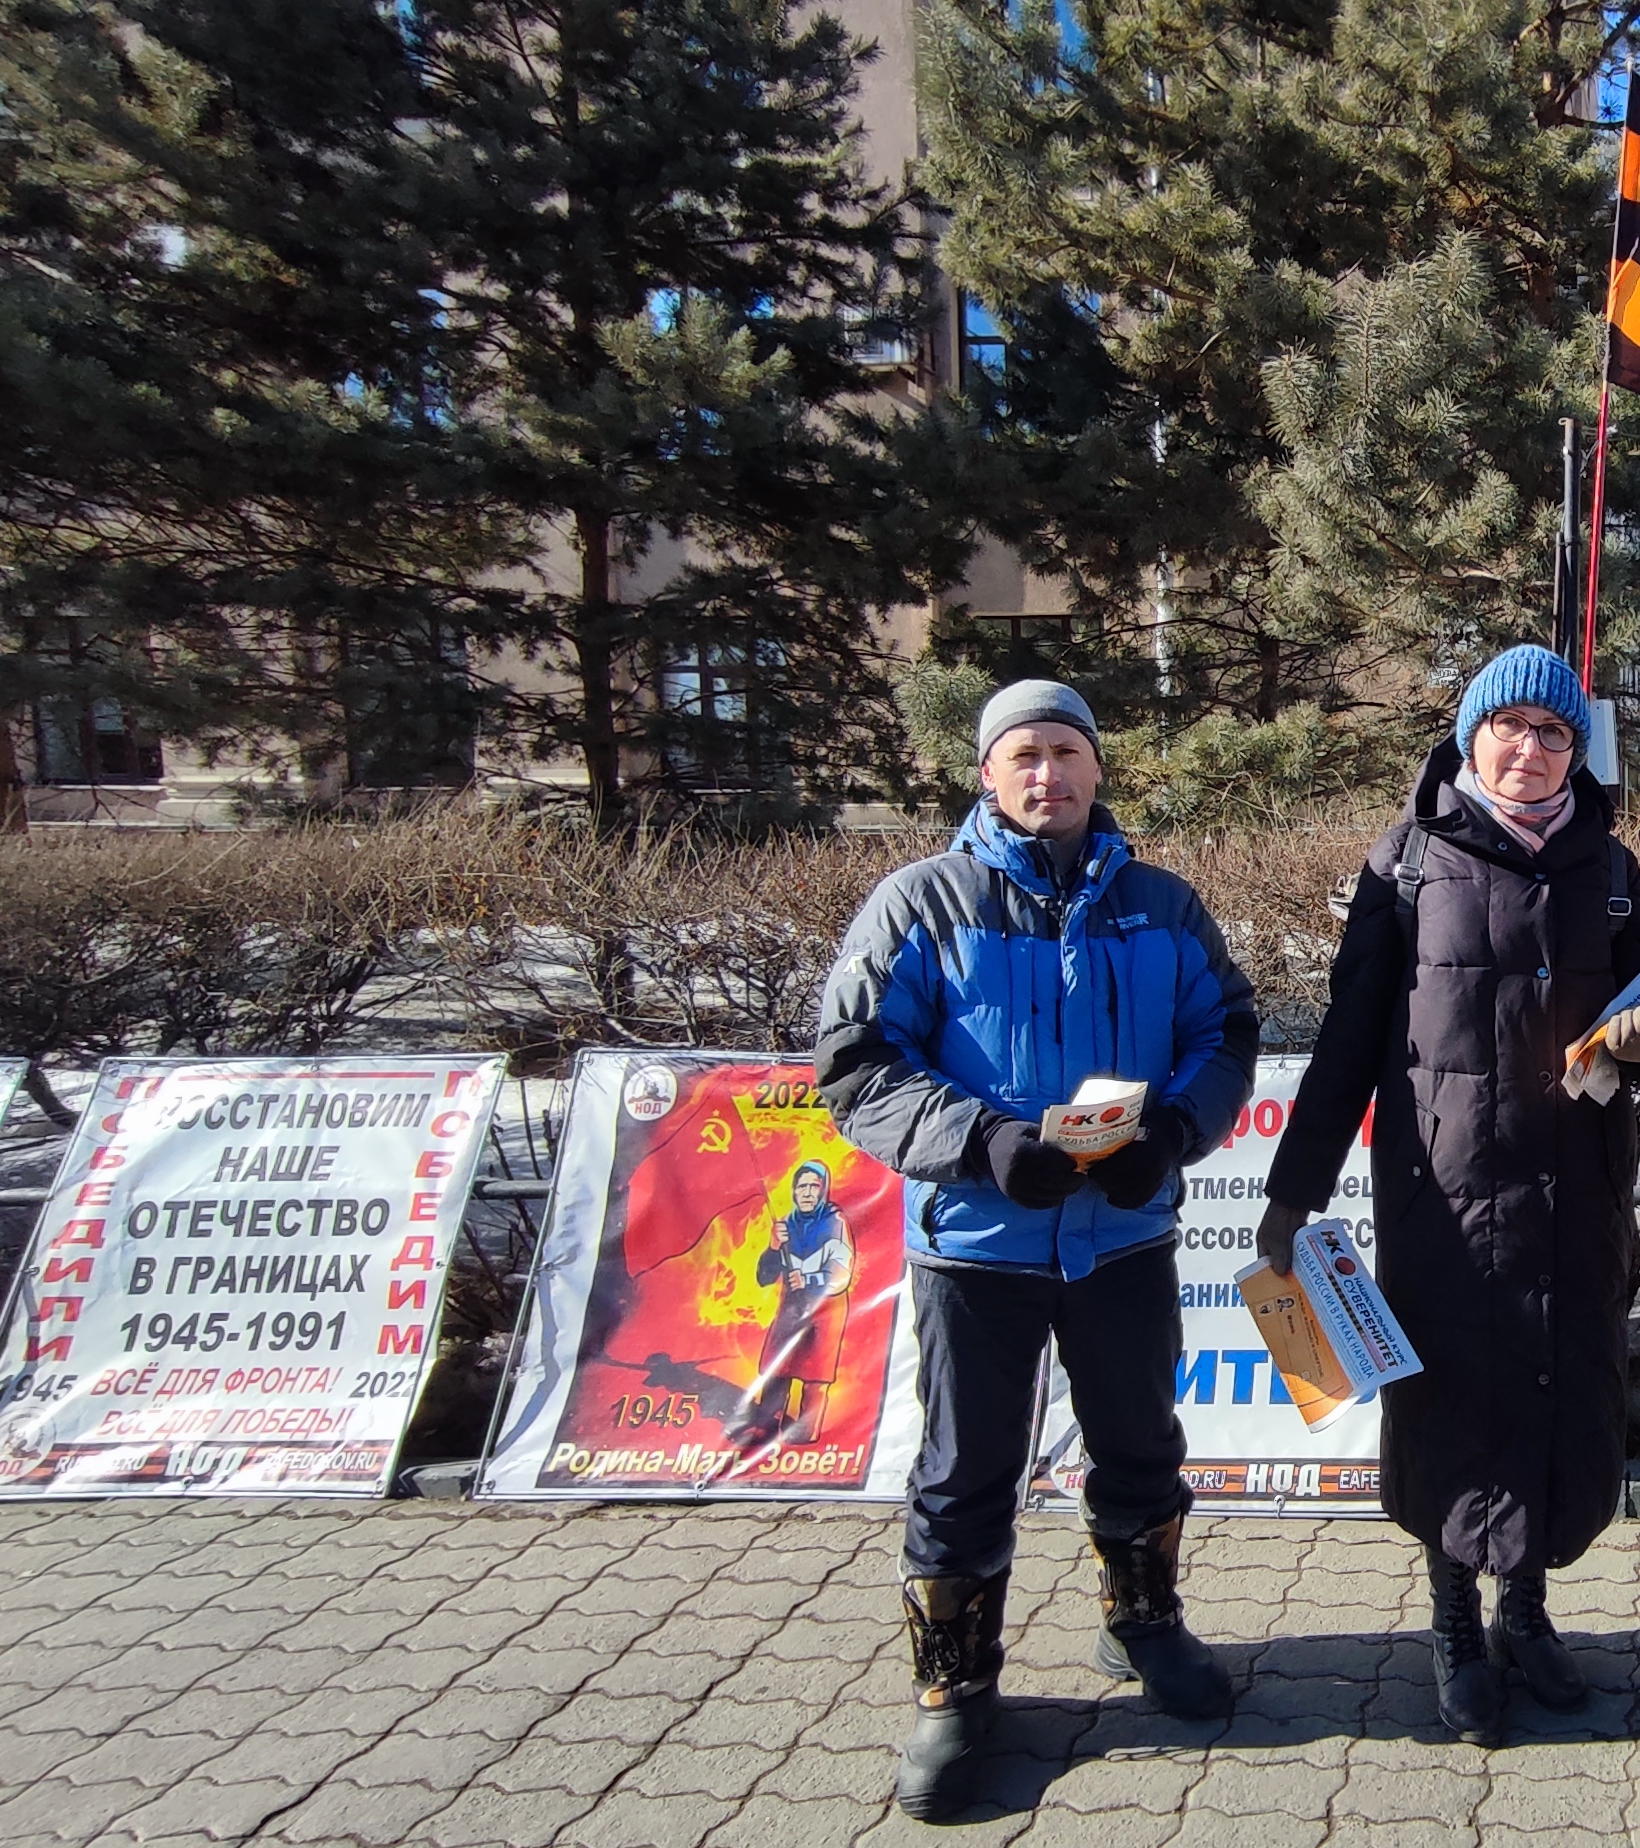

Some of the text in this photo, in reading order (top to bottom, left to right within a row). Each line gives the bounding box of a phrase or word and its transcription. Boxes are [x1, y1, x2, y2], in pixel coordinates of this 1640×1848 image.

[635, 1102, 662, 1115] НОД
[1061, 1112, 1097, 1126] НК
[1057, 1134, 1099, 1145] СУДЬБА
[213, 1145, 341, 1182] НАШЕ
[127, 1198, 391, 1240] ОТЕЧЕСТВО
[1295, 1240, 1318, 1274] СУДЬБА
[1319, 1230, 1345, 1256] НК
[128, 1254, 373, 1301] В ГРАНИЦАХ
[1313, 1270, 1334, 1307] РОССИИ
[1328, 1306, 1341, 1316] В
[1342, 1278, 1399, 1369] СУВЕРЕНИТЕТ
[1353, 1276, 1408, 1366] НАЦИОНАЛЬНЫЙ КУРС
[119, 1311, 348, 1353] 1945-1991
[1333, 1314, 1356, 1345] РУКАХ
[1348, 1341, 1375, 1381] НАРОДА
[0, 1374, 79, 1403] 1945
[90, 1361, 345, 1402] ВСЁ ДЛЯ ФРОНТА!
[150, 1409, 222, 1441] ДЛЯ
[219, 1407, 356, 1440] ПОБЕДЫ!
[610, 1393, 699, 1429] 1945
[758, 1443, 867, 1476] Зовёт!
[1246, 1463, 1322, 1497] НОД
